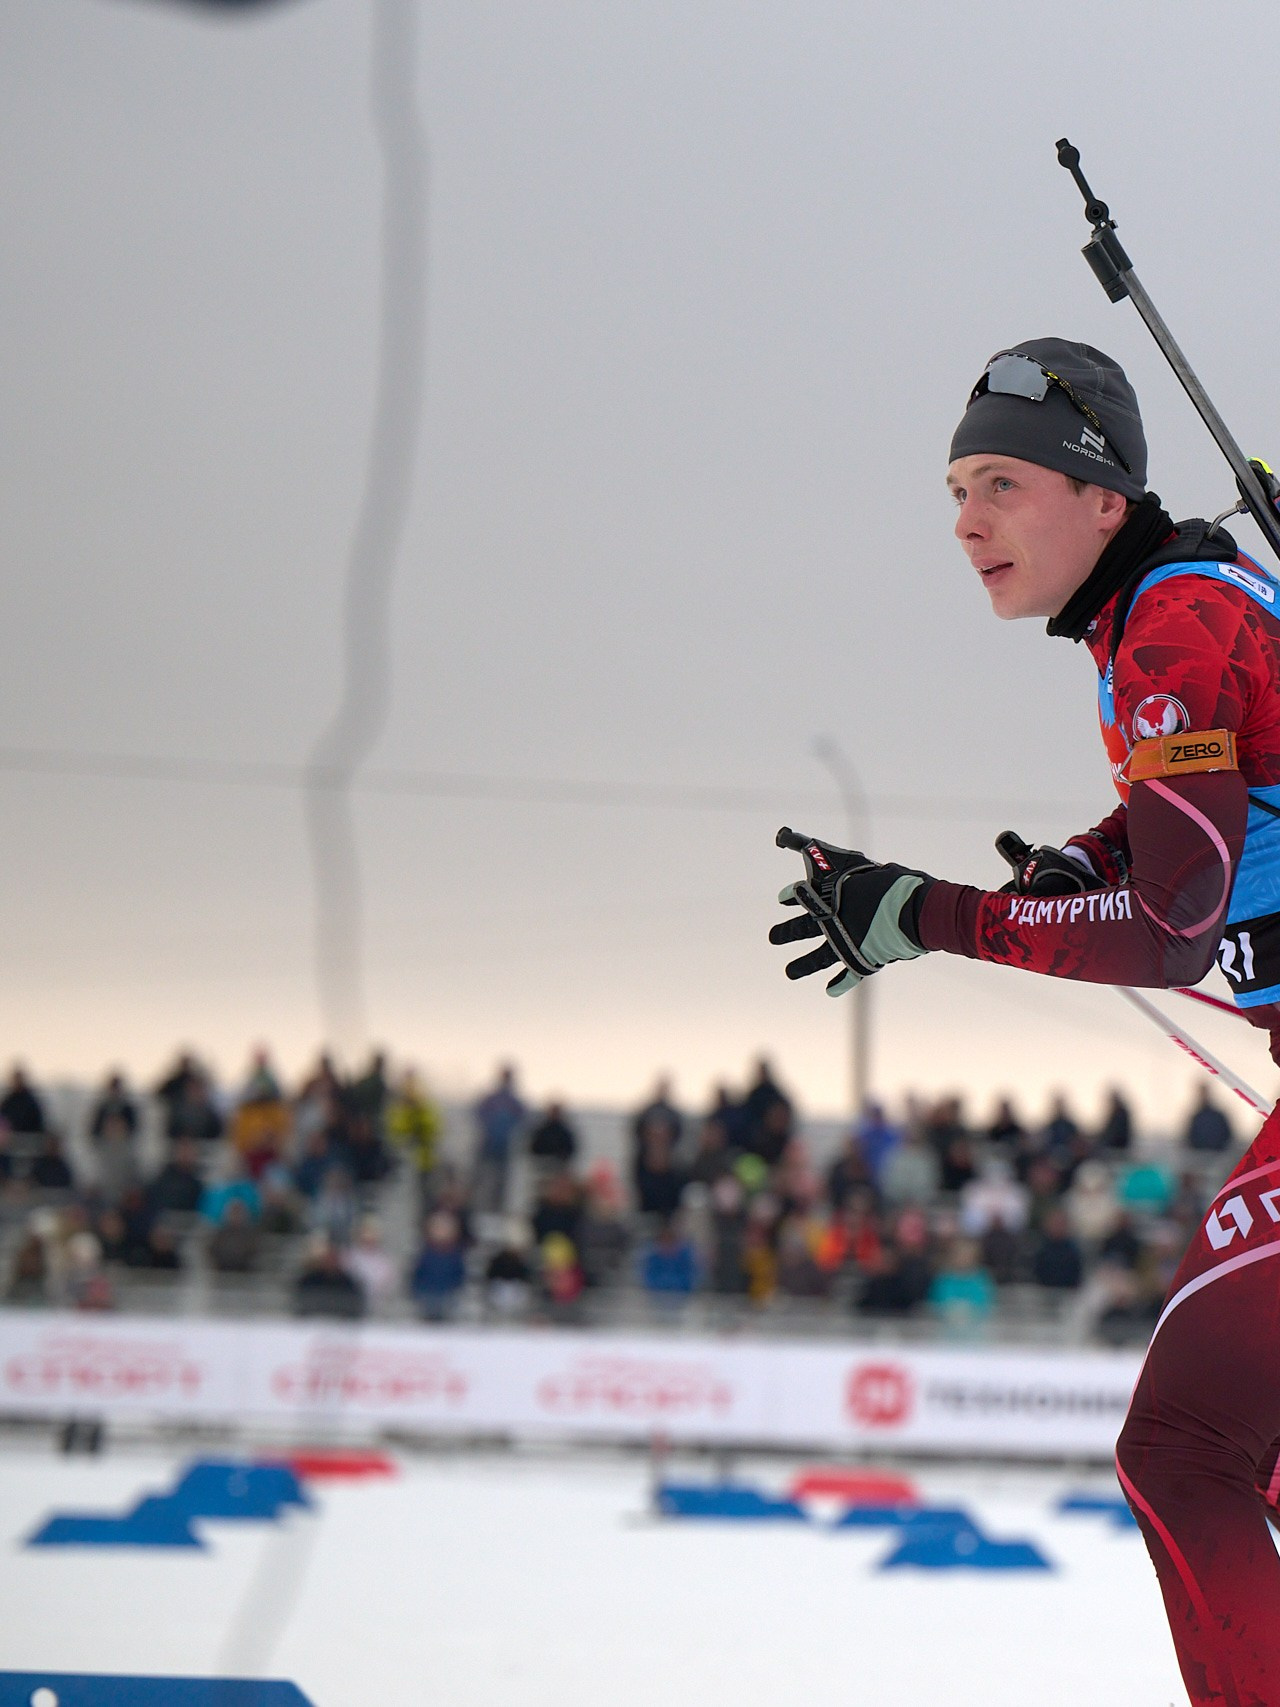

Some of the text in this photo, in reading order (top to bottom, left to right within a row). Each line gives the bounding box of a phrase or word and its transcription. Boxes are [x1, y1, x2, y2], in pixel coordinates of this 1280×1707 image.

[1062, 440, 1115, 467] NORDSKI
[1169, 742, 1224, 763] ZERO
[1008, 889, 1133, 927] УДМУРТИЯ
